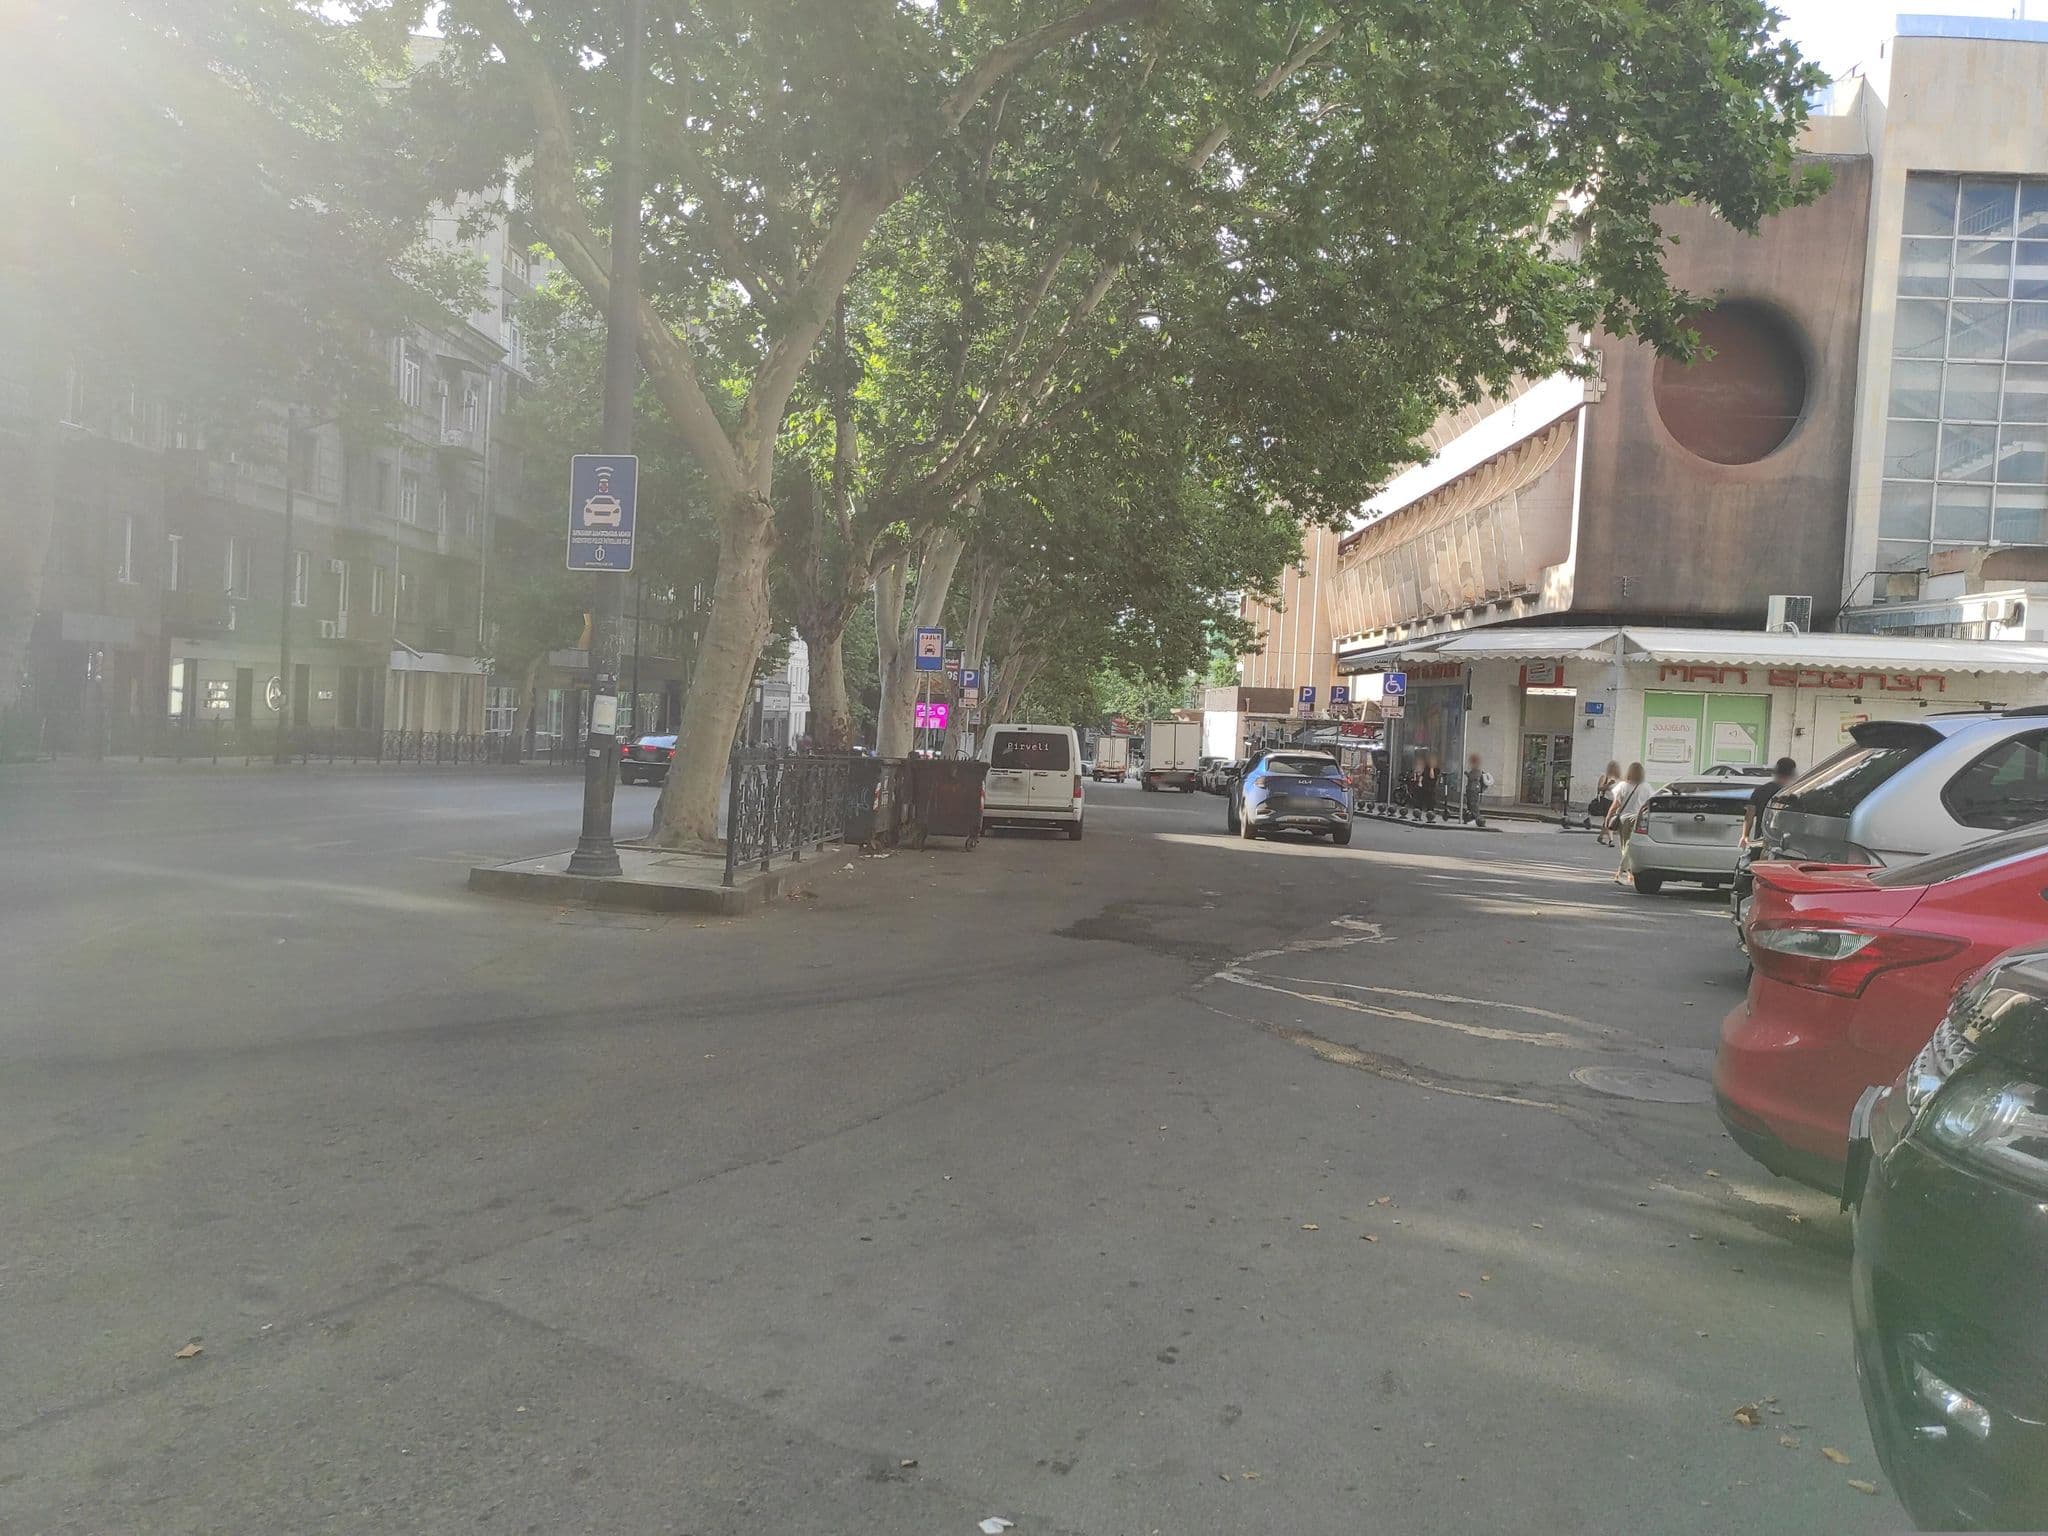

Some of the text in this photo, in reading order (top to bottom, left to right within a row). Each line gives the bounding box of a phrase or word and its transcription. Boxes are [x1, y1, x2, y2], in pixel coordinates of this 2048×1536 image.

[964, 671, 974, 686] P
[1302, 688, 1313, 701] P
[1336, 687, 1345, 698] P
[1007, 742, 1049, 751] Pirveli
